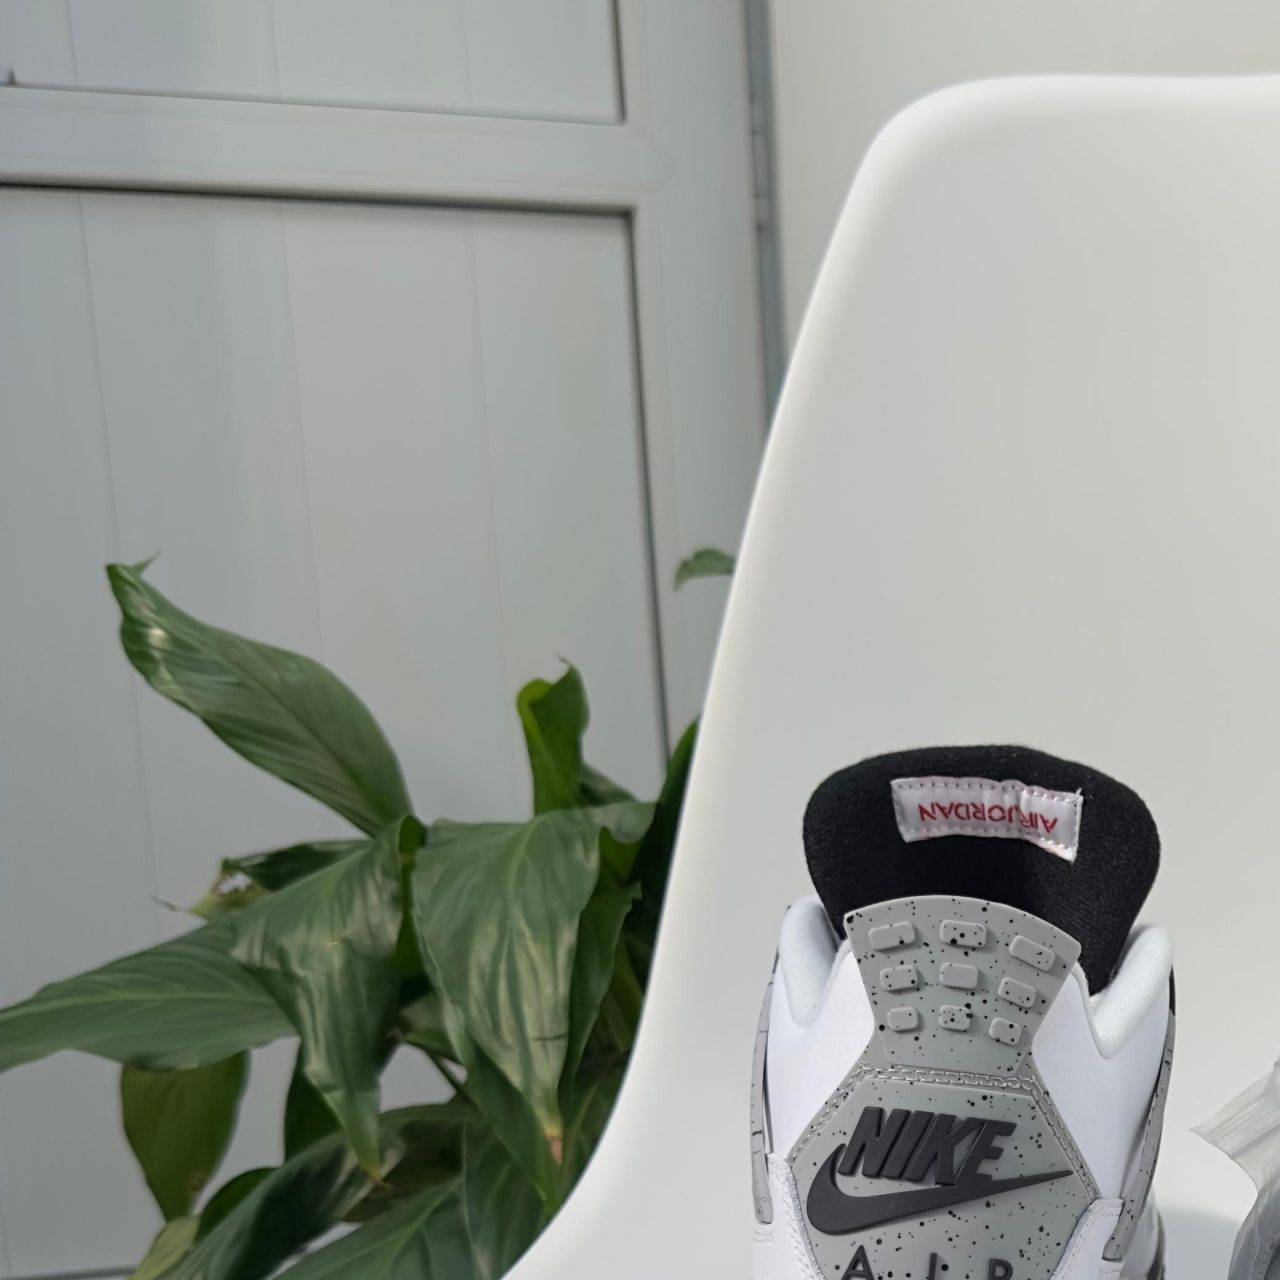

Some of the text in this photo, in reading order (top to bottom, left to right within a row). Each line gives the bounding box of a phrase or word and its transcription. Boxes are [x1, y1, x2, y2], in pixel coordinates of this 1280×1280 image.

[917, 801, 1058, 833] AIR JORDAN
[837, 1105, 1018, 1186] NIKE
